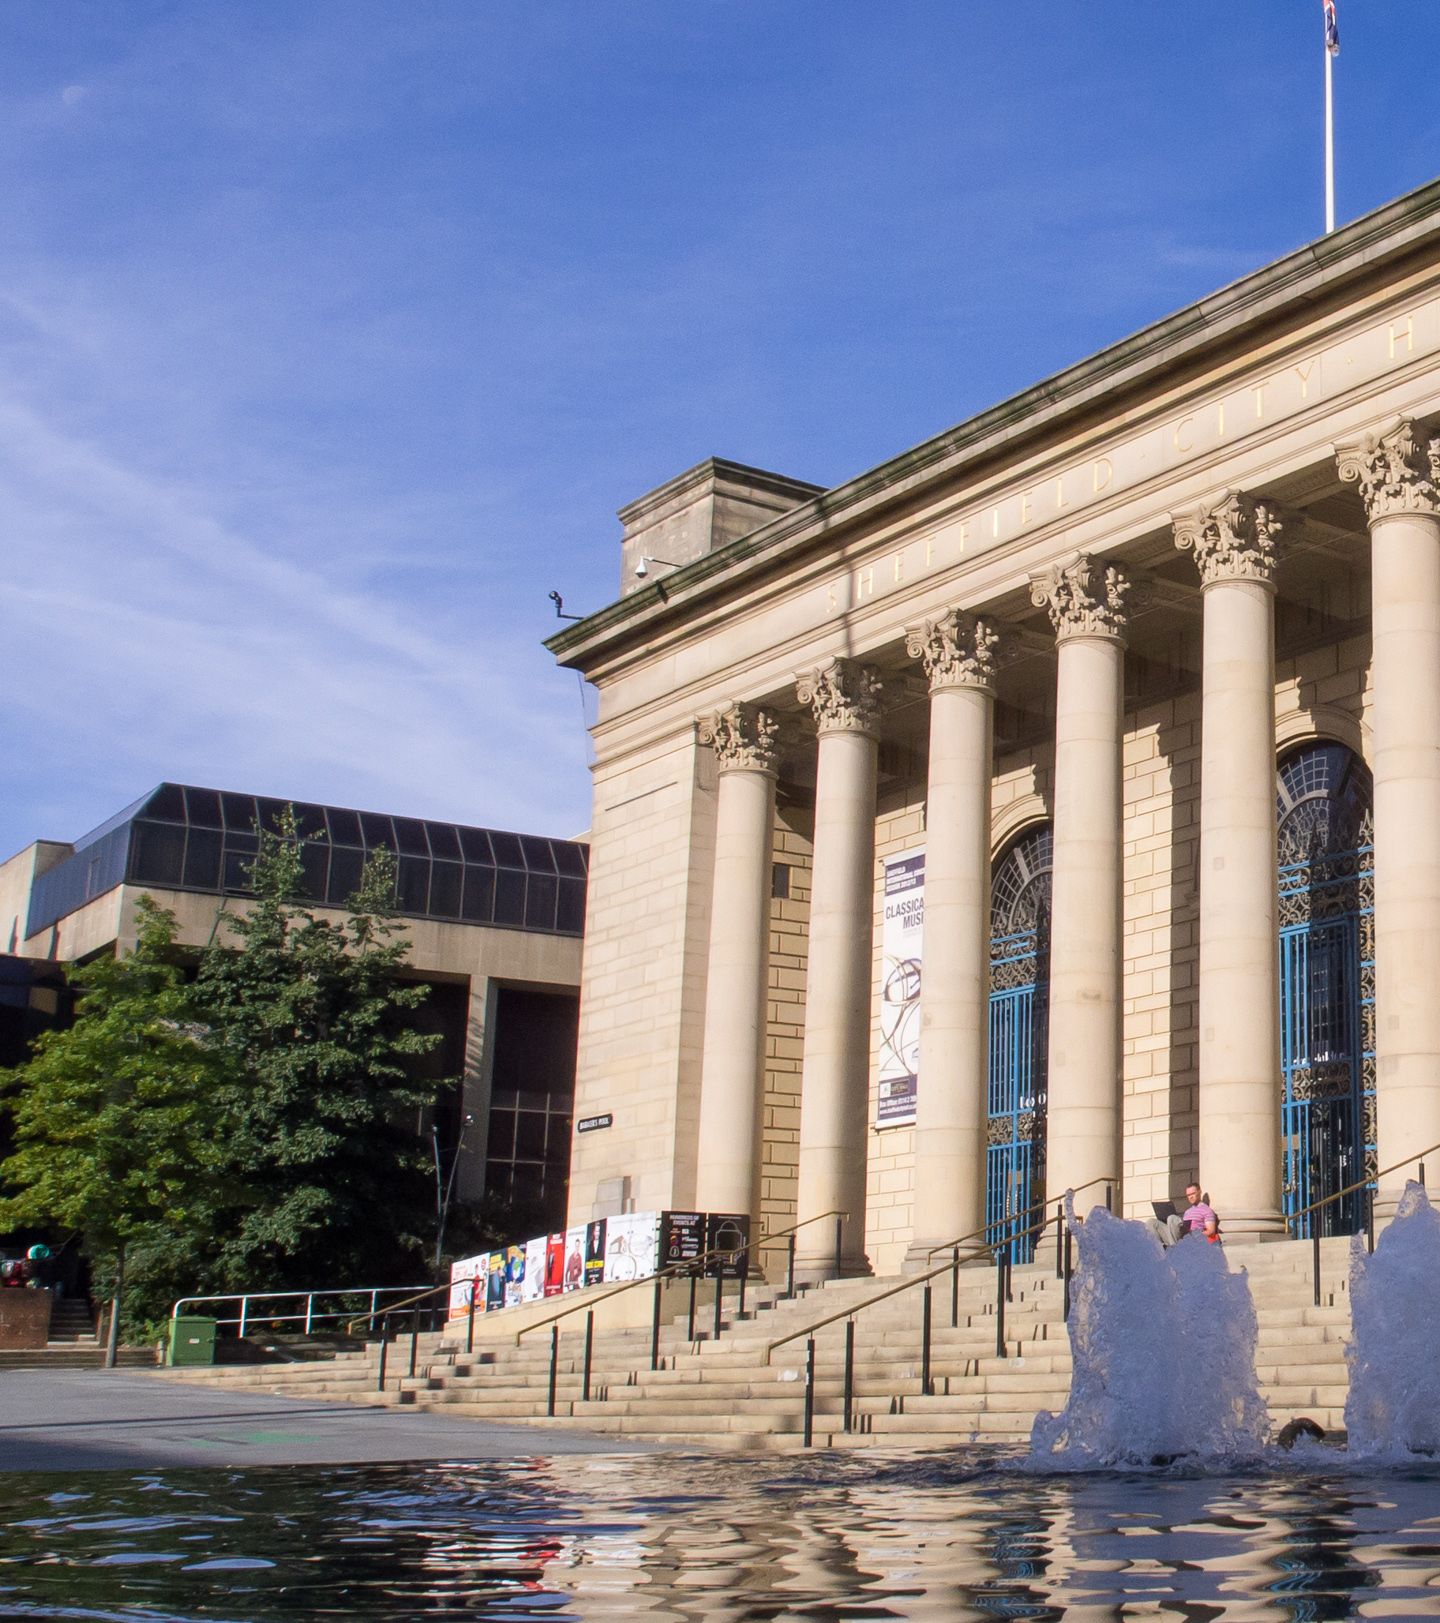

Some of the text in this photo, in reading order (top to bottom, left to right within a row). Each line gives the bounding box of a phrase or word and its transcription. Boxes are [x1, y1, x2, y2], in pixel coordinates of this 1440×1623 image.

[826, 457, 1112, 614] SHEFFIELD
[1173, 359, 1316, 452] CITY
[885, 896, 924, 920] CLASSICA
[903, 911, 924, 930] MUSI
